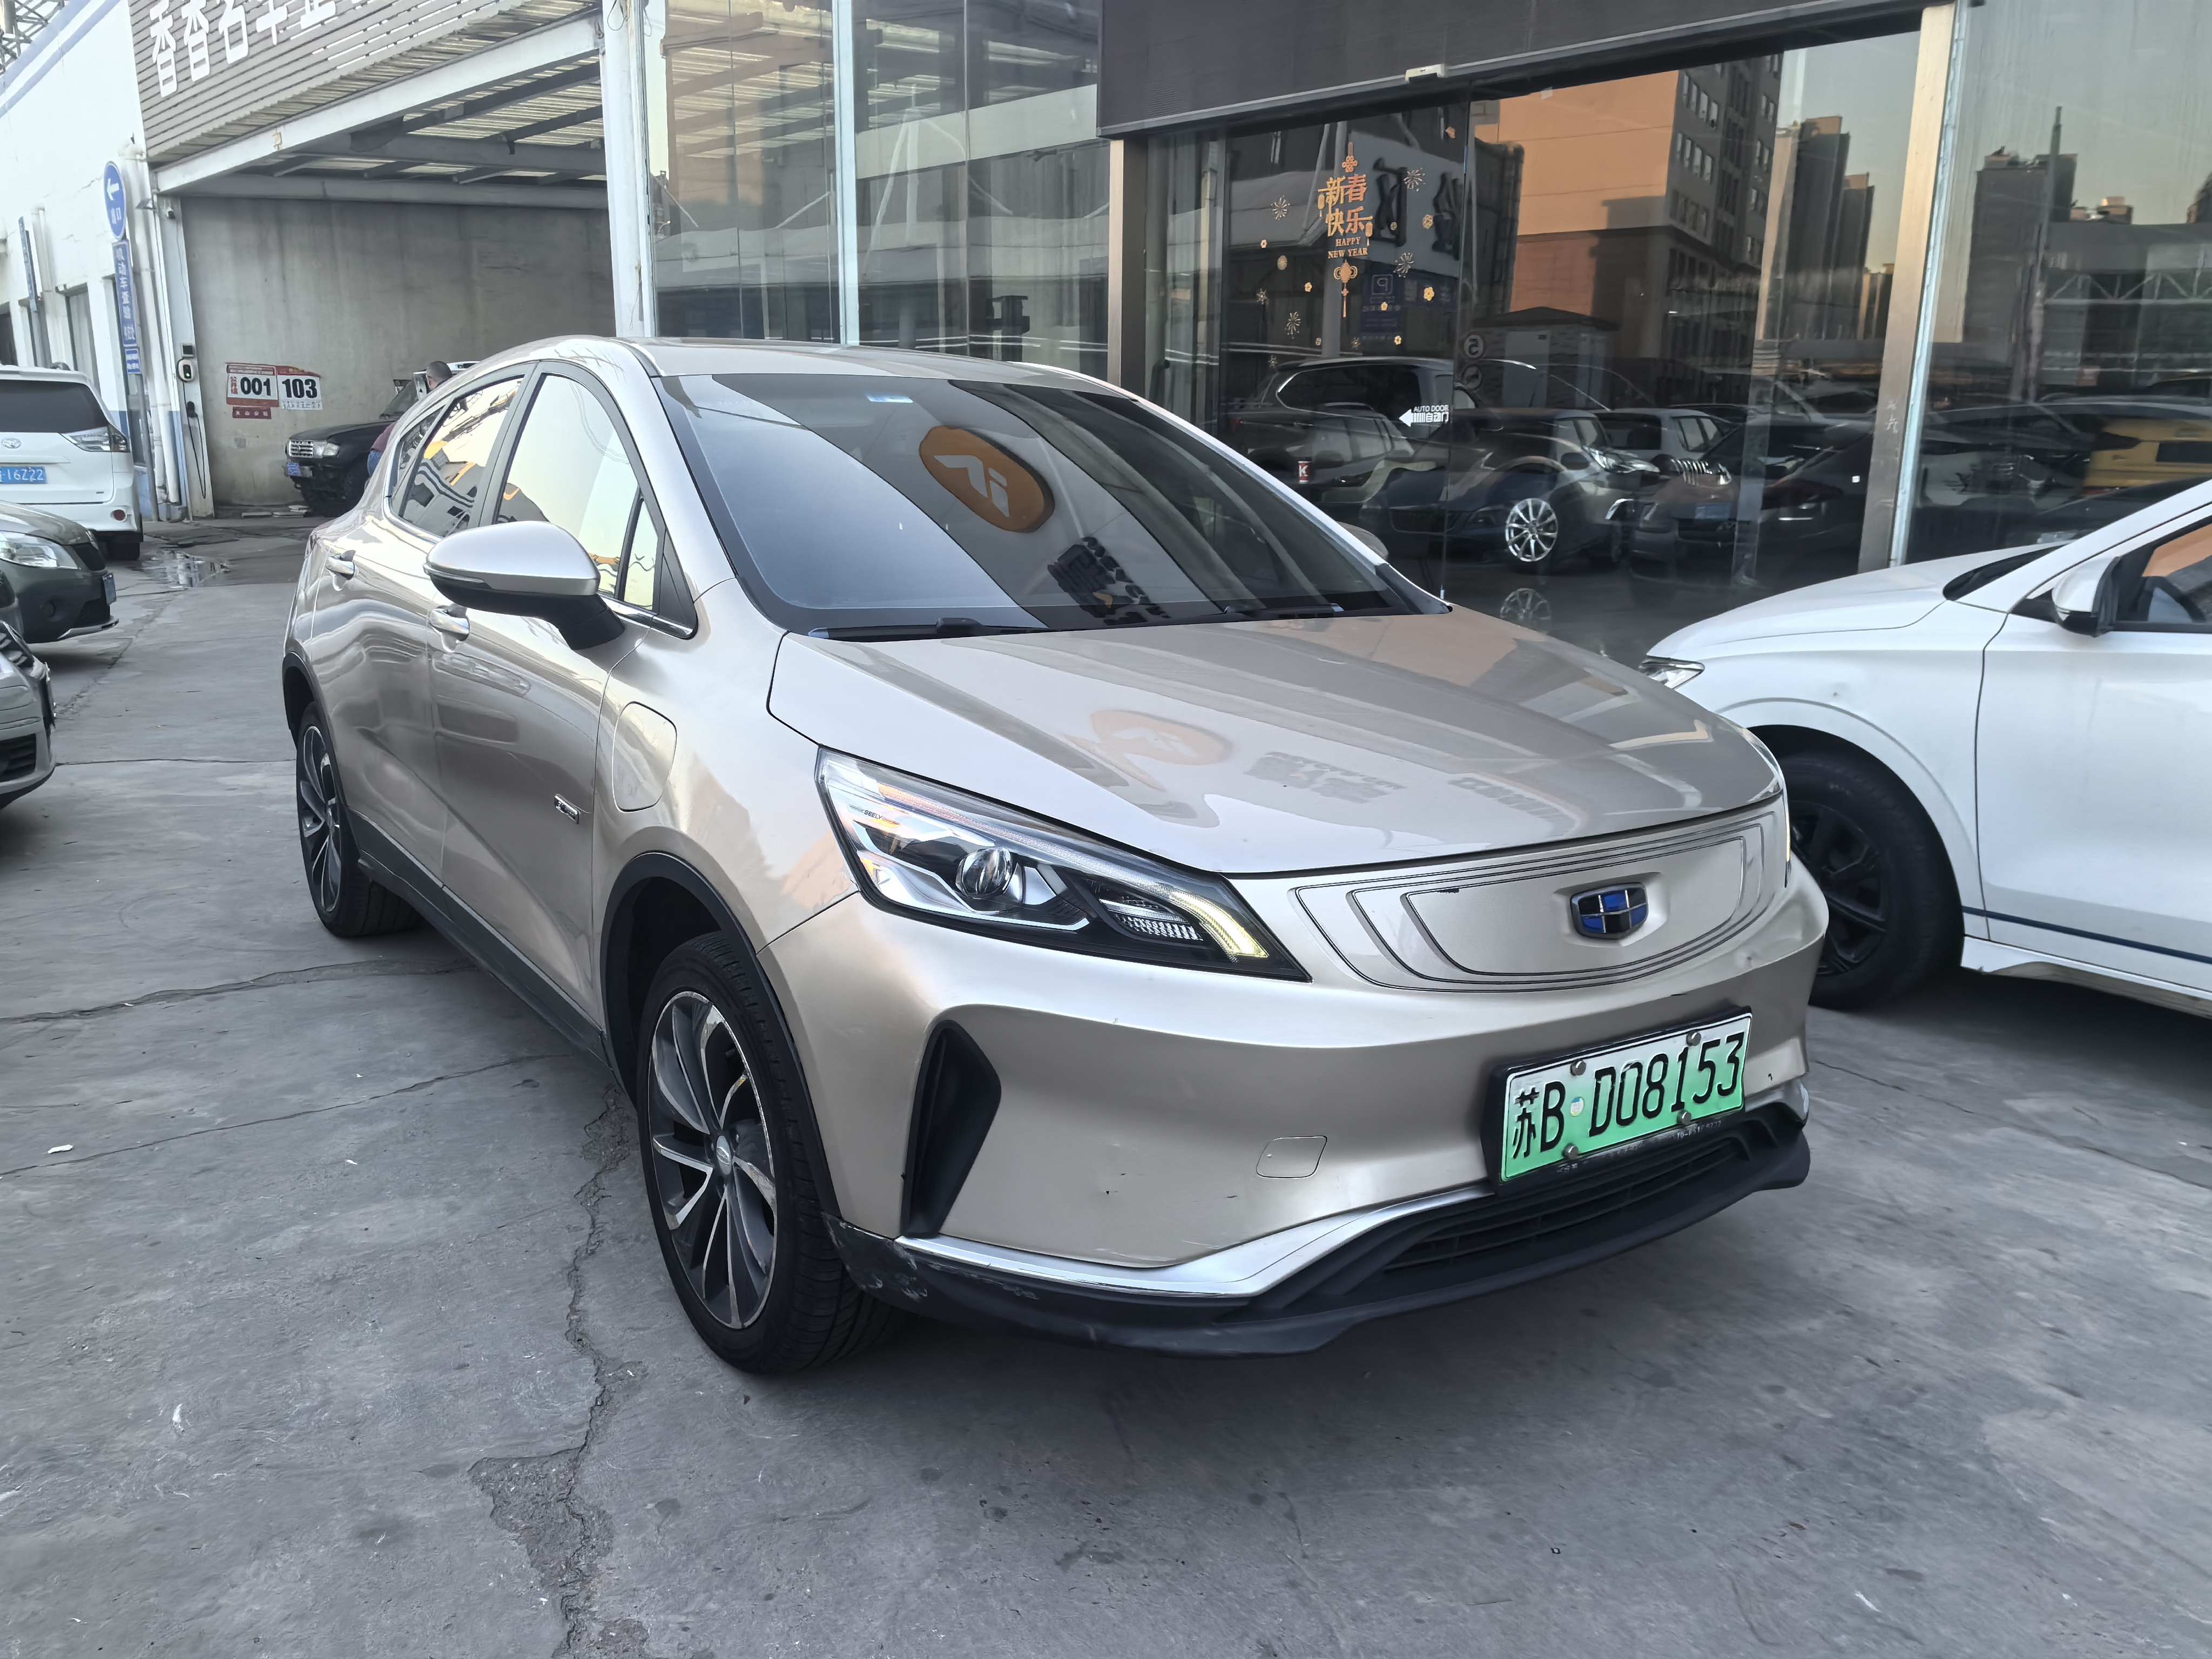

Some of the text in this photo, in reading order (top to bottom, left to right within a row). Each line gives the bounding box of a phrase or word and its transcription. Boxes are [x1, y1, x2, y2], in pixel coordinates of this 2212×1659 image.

[1318, 174, 1367, 206] 新春
[1325, 206, 1373, 237] 快乐
[1336, 237, 1361, 247] HAPPY
[1328, 247, 1368, 259] NEW YEAR
[240, 377, 271, 396] 001
[282, 379, 318, 398] 103
[1426, 412, 1449, 424] 自动门
[864, 810, 883, 819] GEELY
